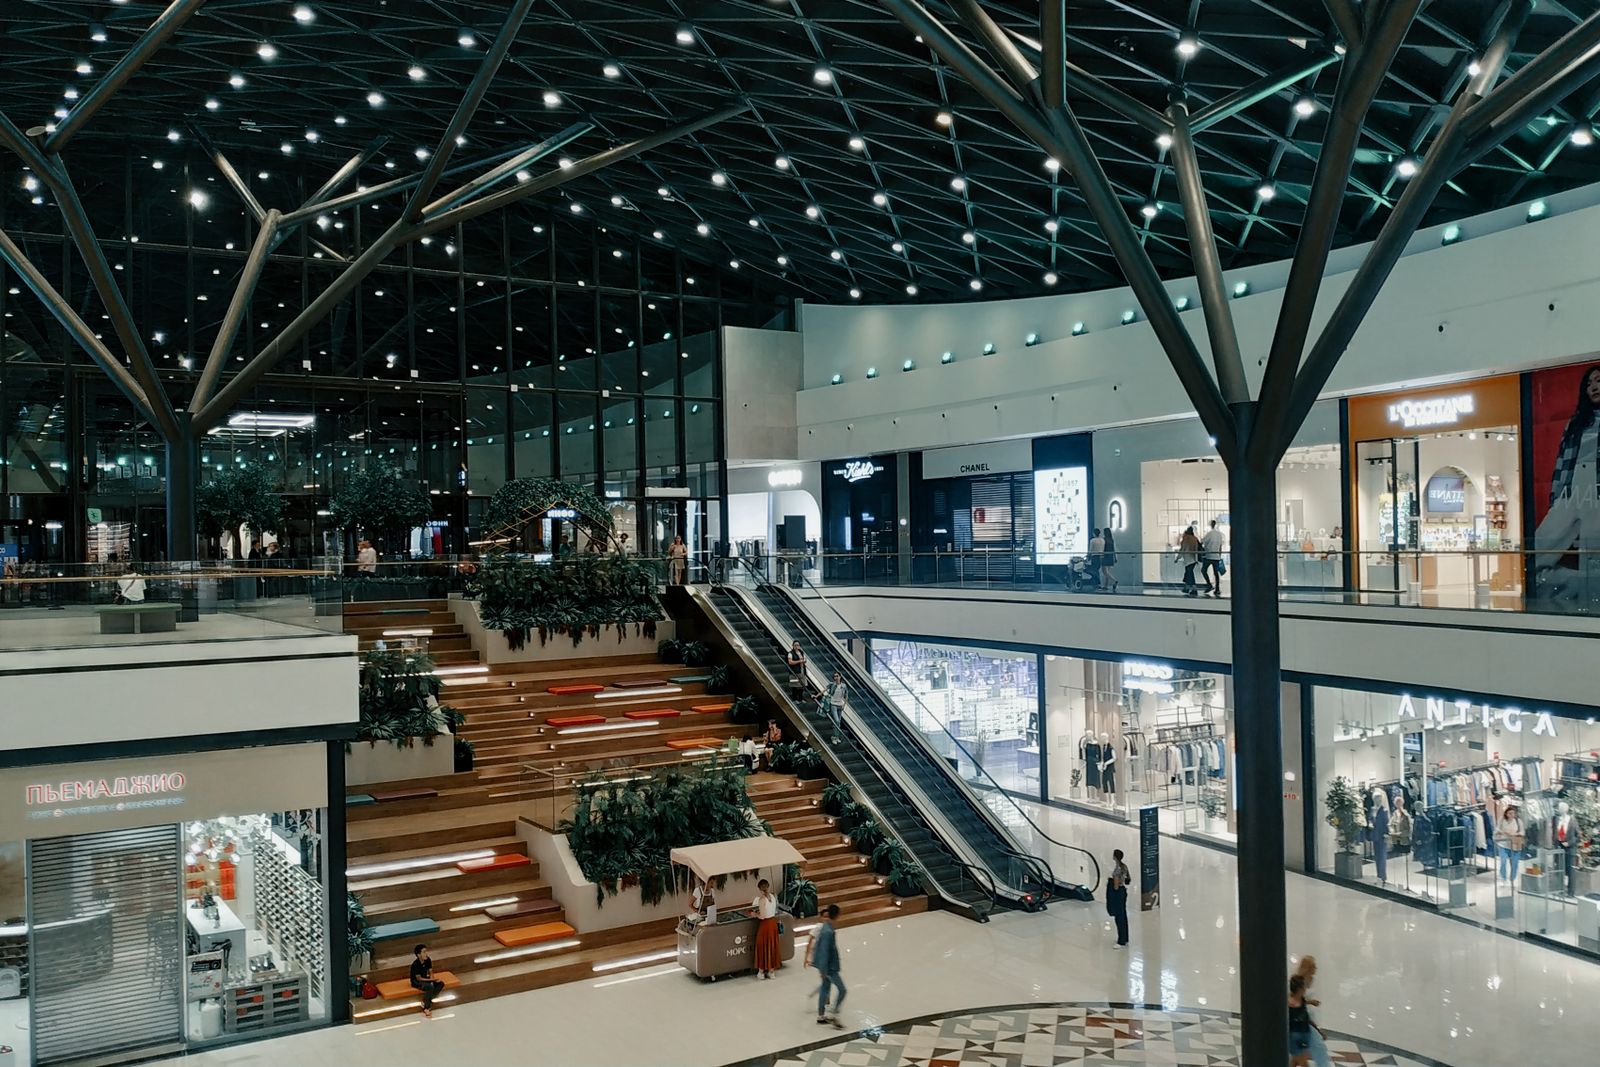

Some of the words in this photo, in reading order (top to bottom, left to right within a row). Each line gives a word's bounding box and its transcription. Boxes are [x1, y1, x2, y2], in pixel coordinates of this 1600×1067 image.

[1389, 394, 1474, 421] L'OCCITANE
[960, 463, 990, 473] CHANEL
[1398, 694, 1558, 737] ANTIGA
[26, 771, 186, 805] ПЬЕМАДЖИО
